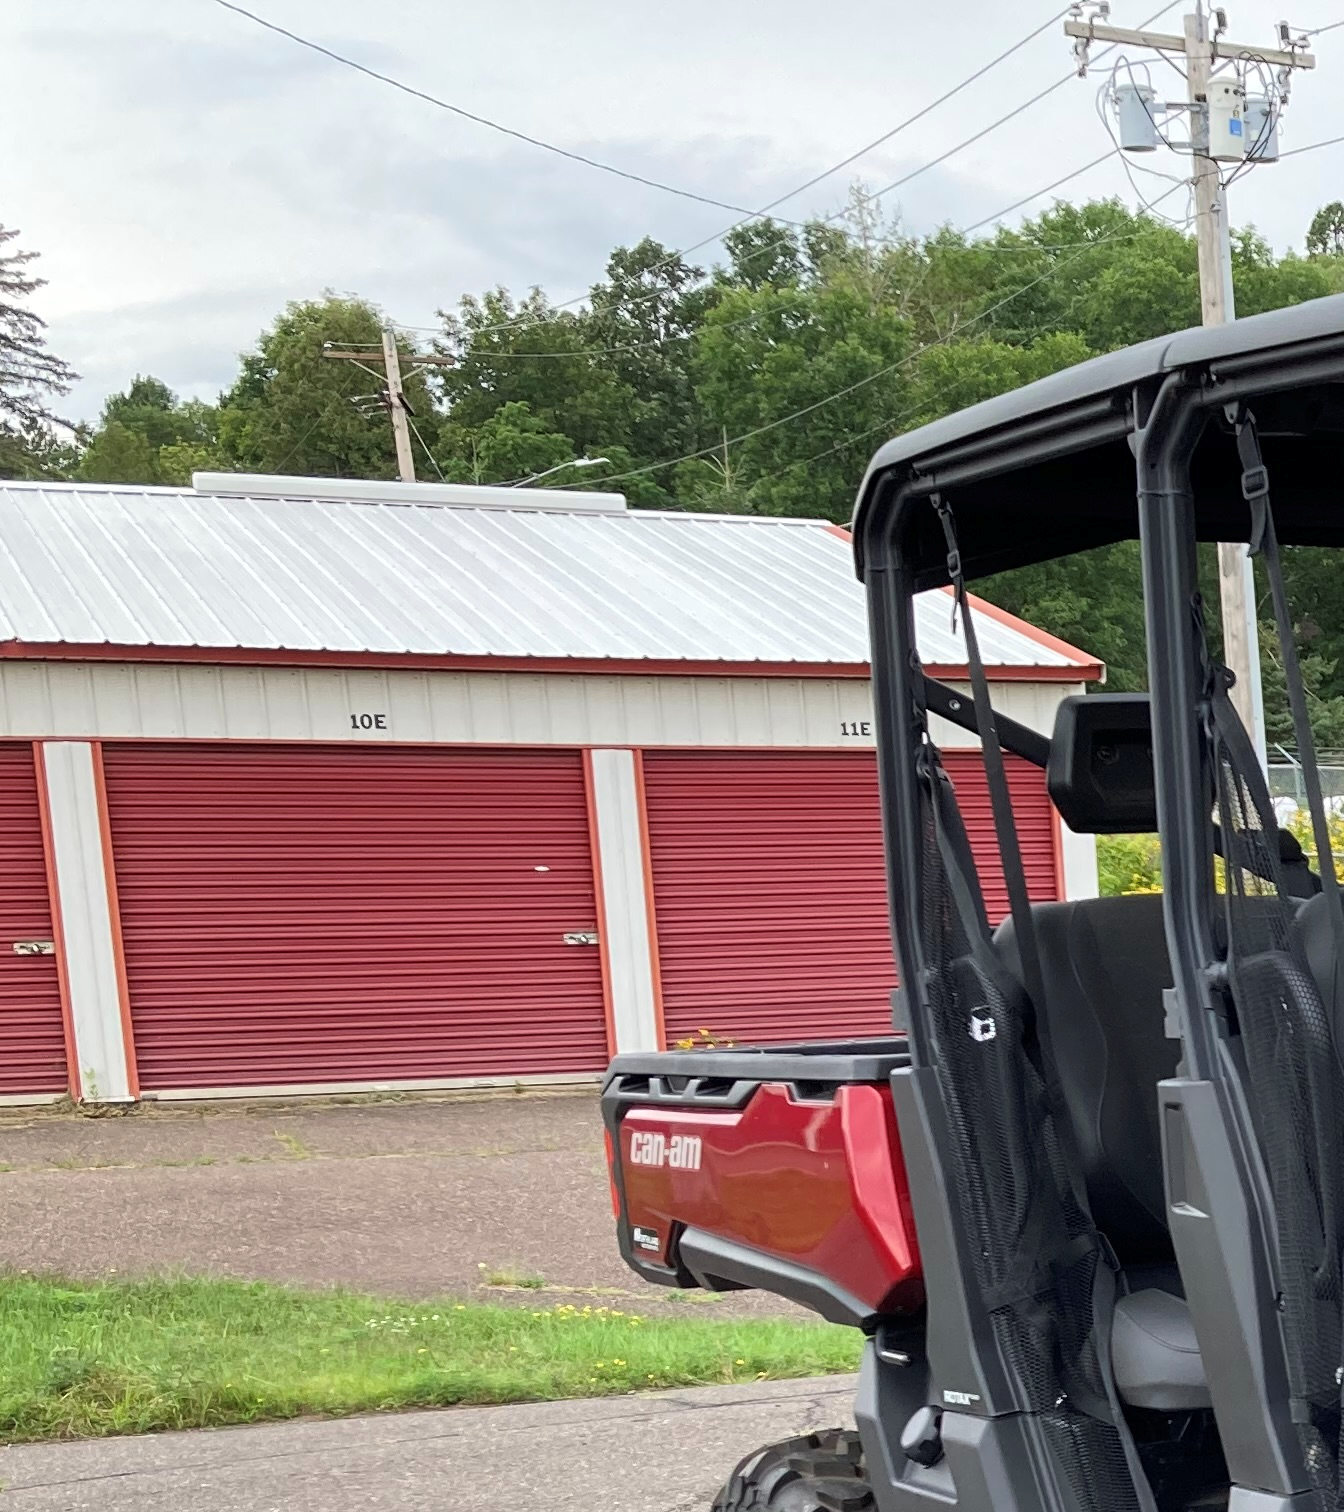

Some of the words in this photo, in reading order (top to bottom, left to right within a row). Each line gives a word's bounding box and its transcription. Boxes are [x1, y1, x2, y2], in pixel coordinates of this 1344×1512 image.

[350, 713, 387, 730] 10E
[840, 721, 871, 737] 11E
[629, 1131, 702, 1170] can-am
